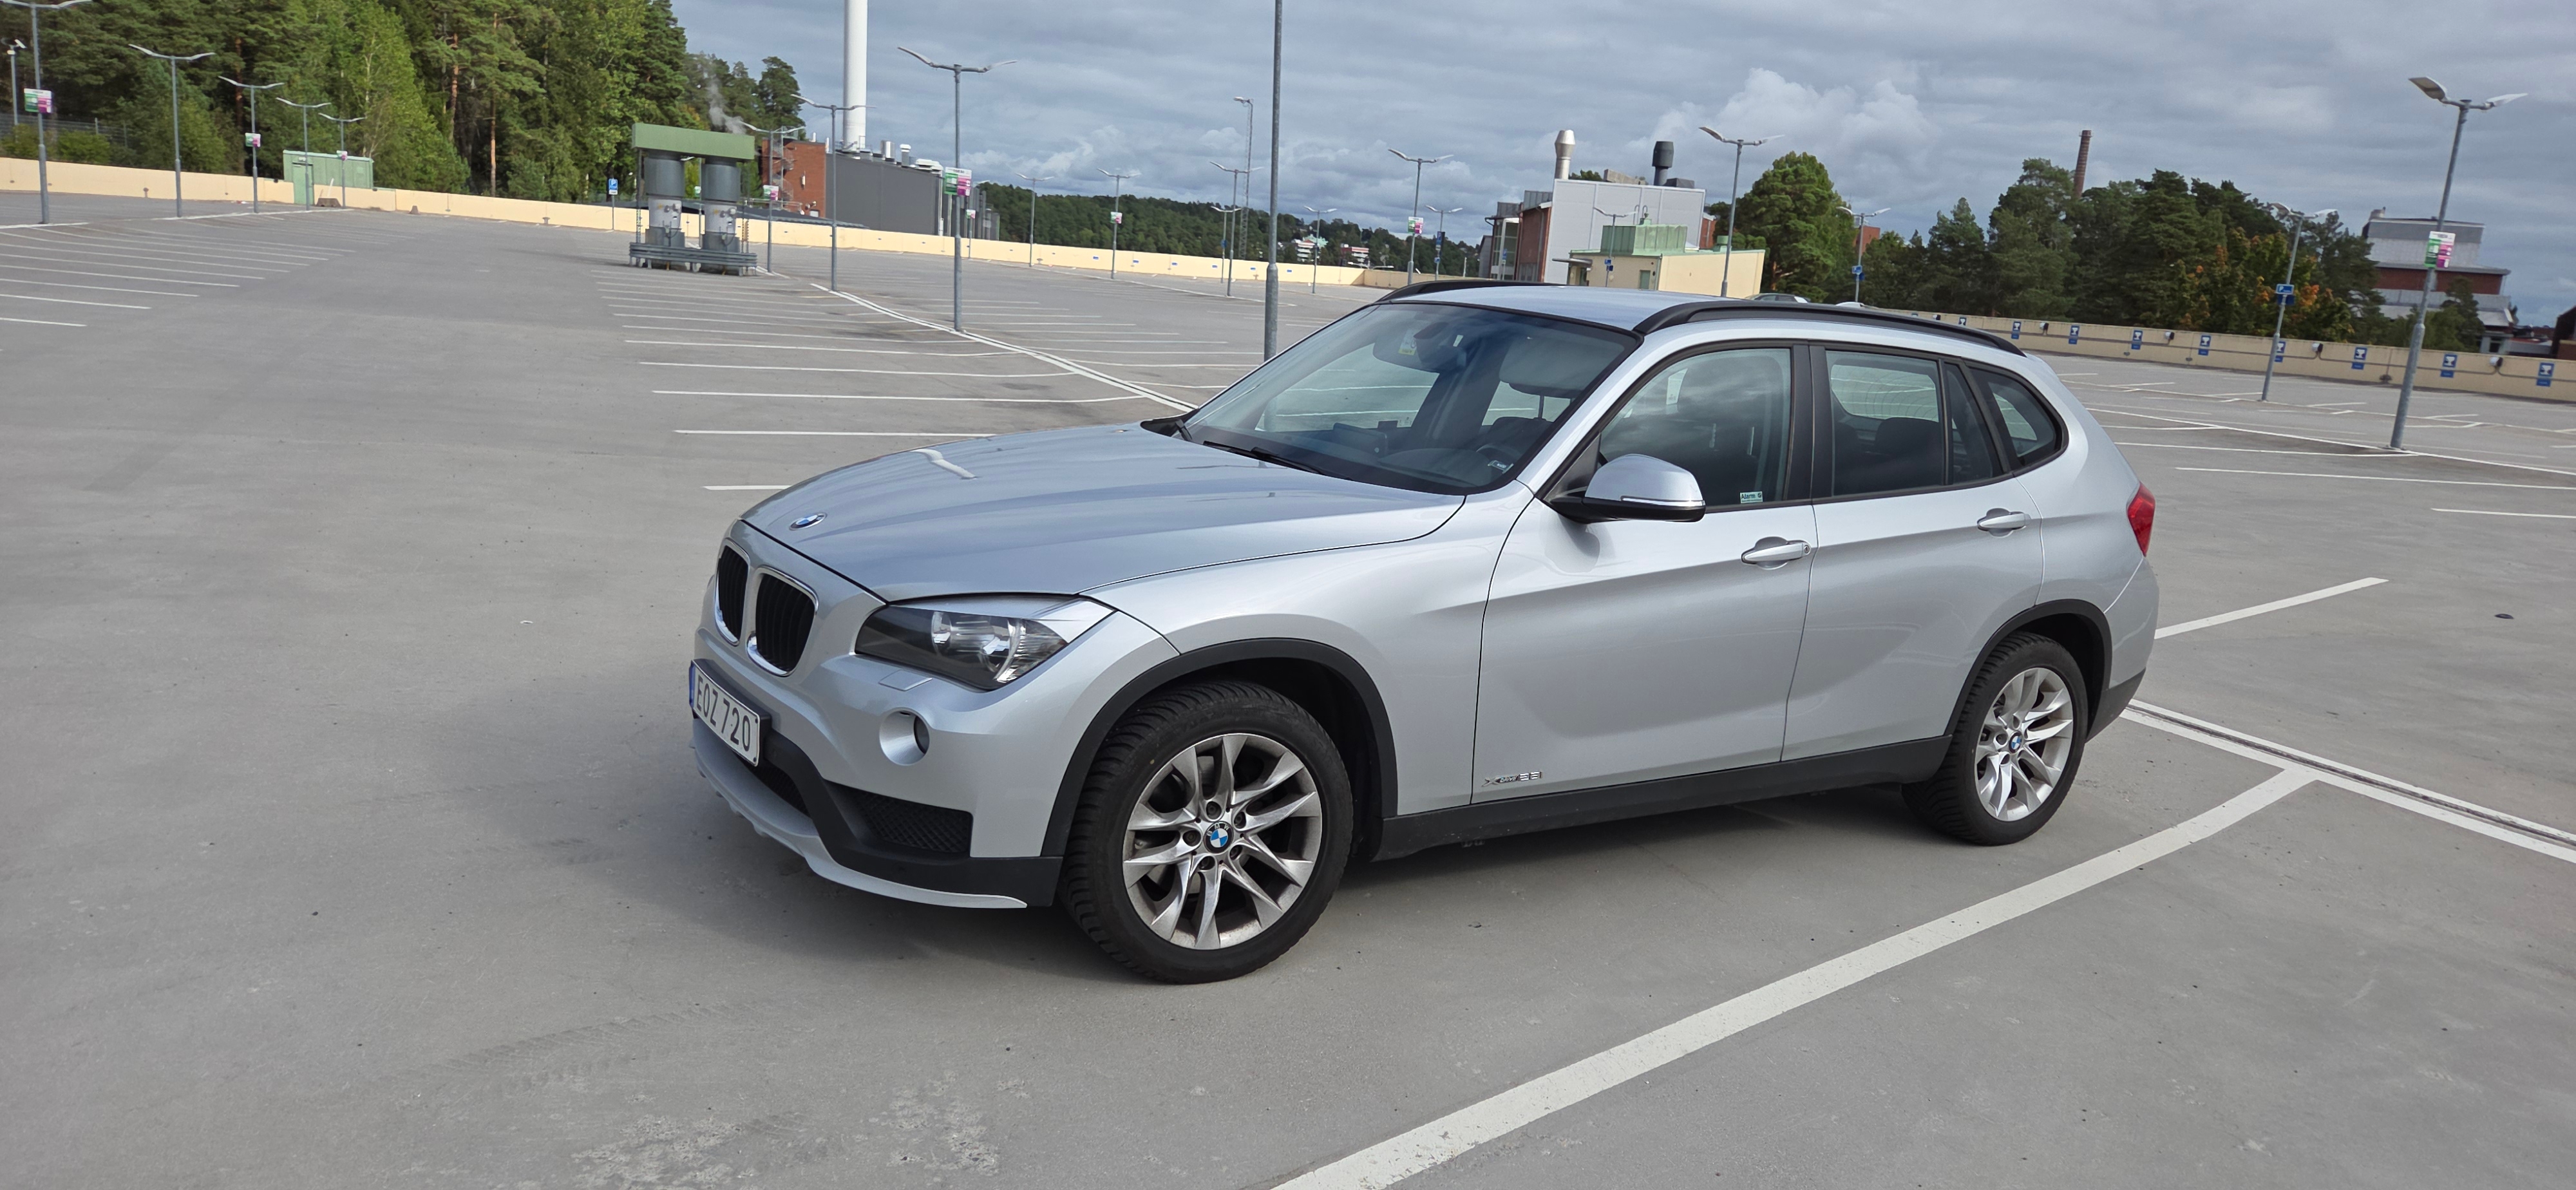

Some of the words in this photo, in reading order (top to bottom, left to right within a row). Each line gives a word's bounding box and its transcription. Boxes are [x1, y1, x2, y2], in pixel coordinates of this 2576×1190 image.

[696, 675, 719, 727] EOZ
[721, 697, 751, 752] 720
[1206, 823, 1229, 836] BMW
